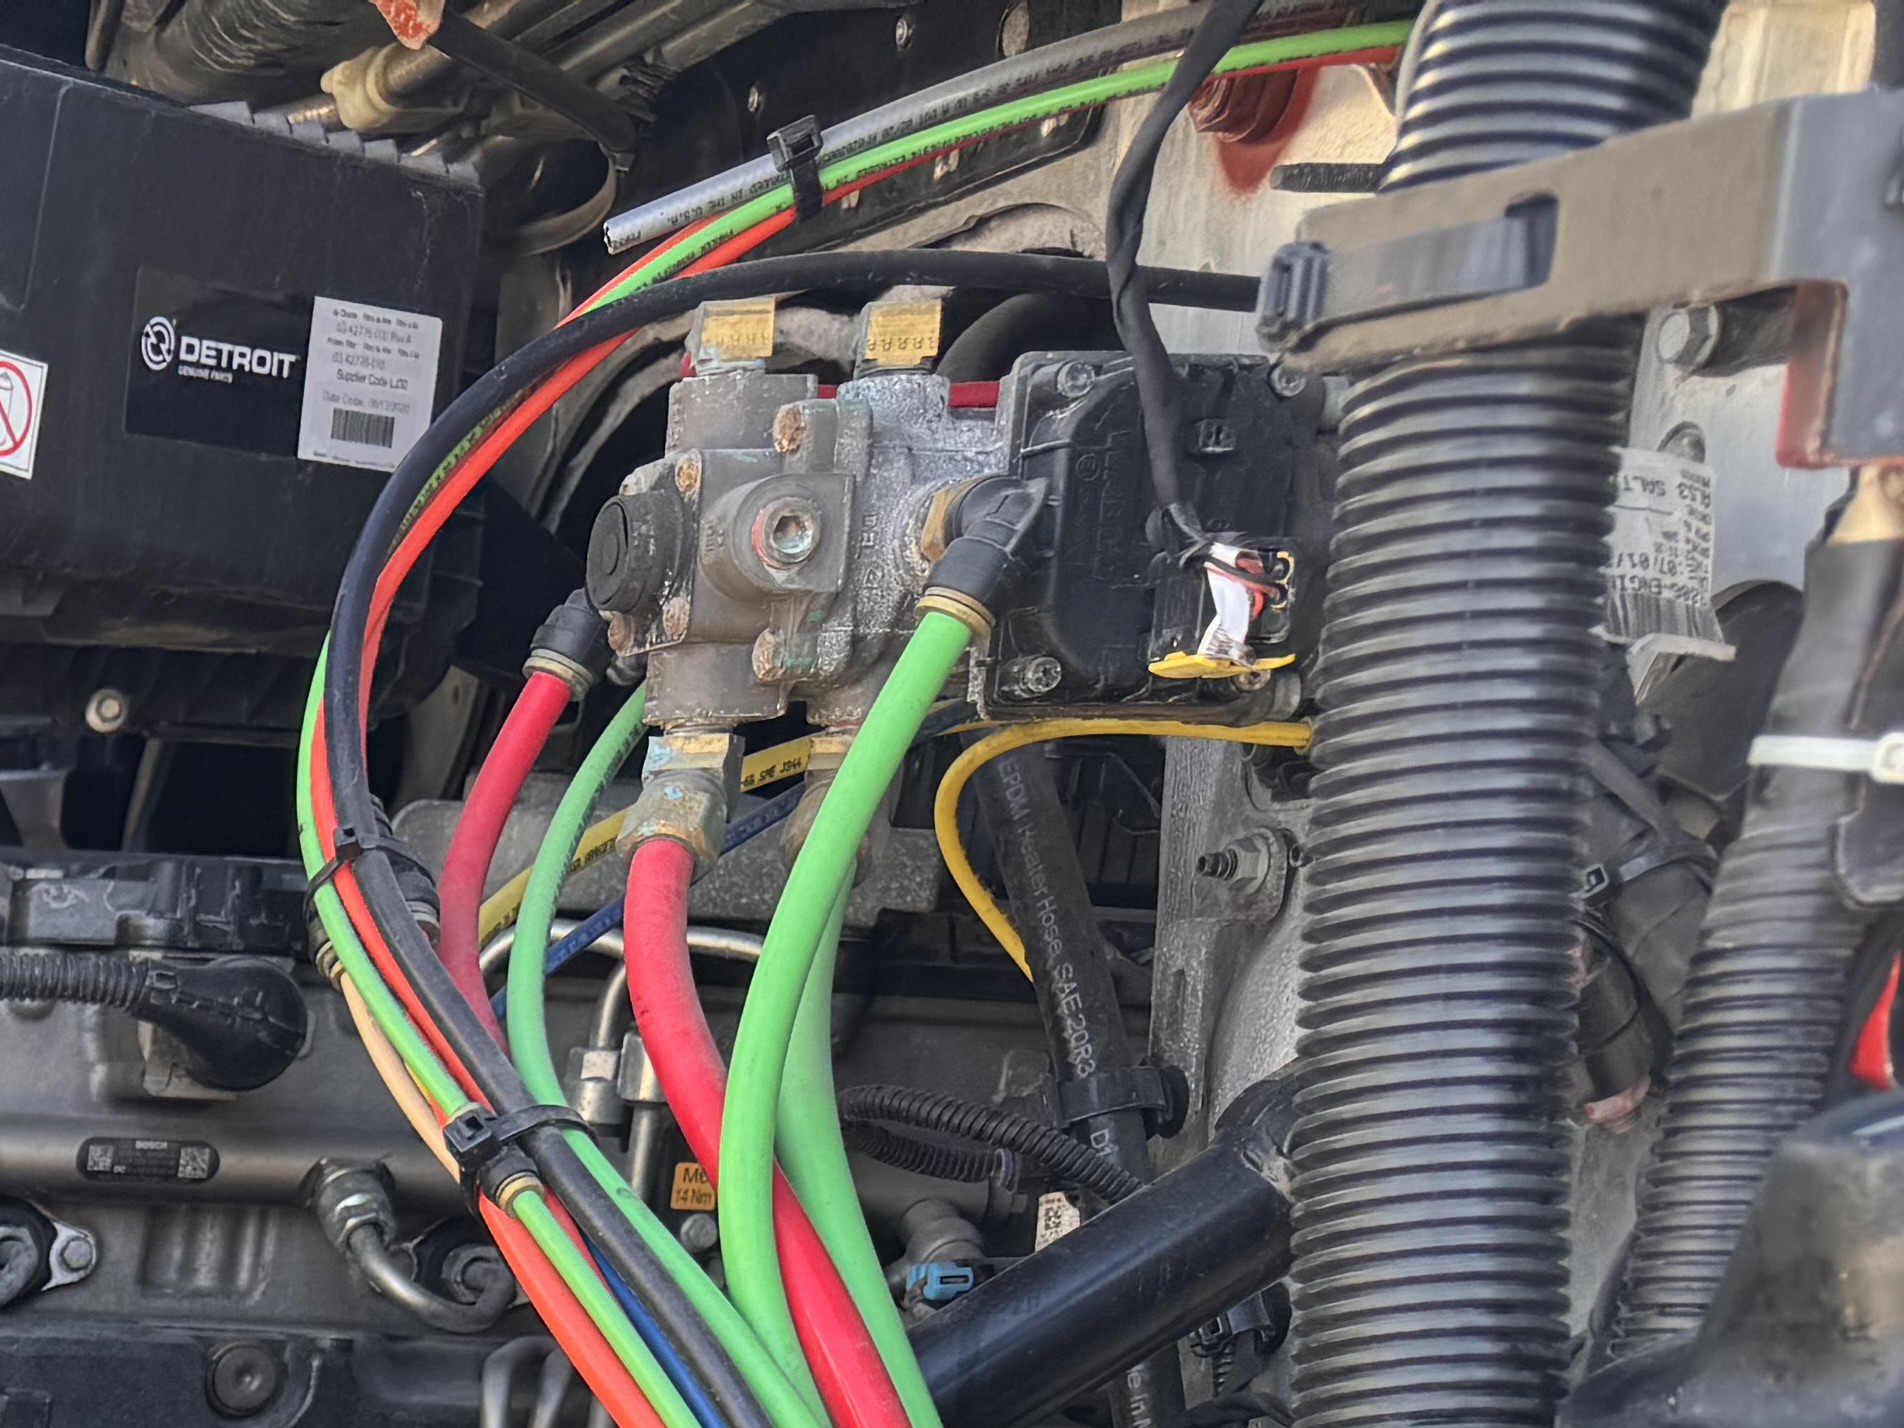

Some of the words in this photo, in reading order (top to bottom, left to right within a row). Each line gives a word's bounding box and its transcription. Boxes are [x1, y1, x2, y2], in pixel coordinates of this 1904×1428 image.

[178, 334, 296, 379] DETROIT
[996, 757, 1030, 821] EPDM
[1056, 961, 1083, 1014] SAE
[691, 1188, 712, 1205] Nm
